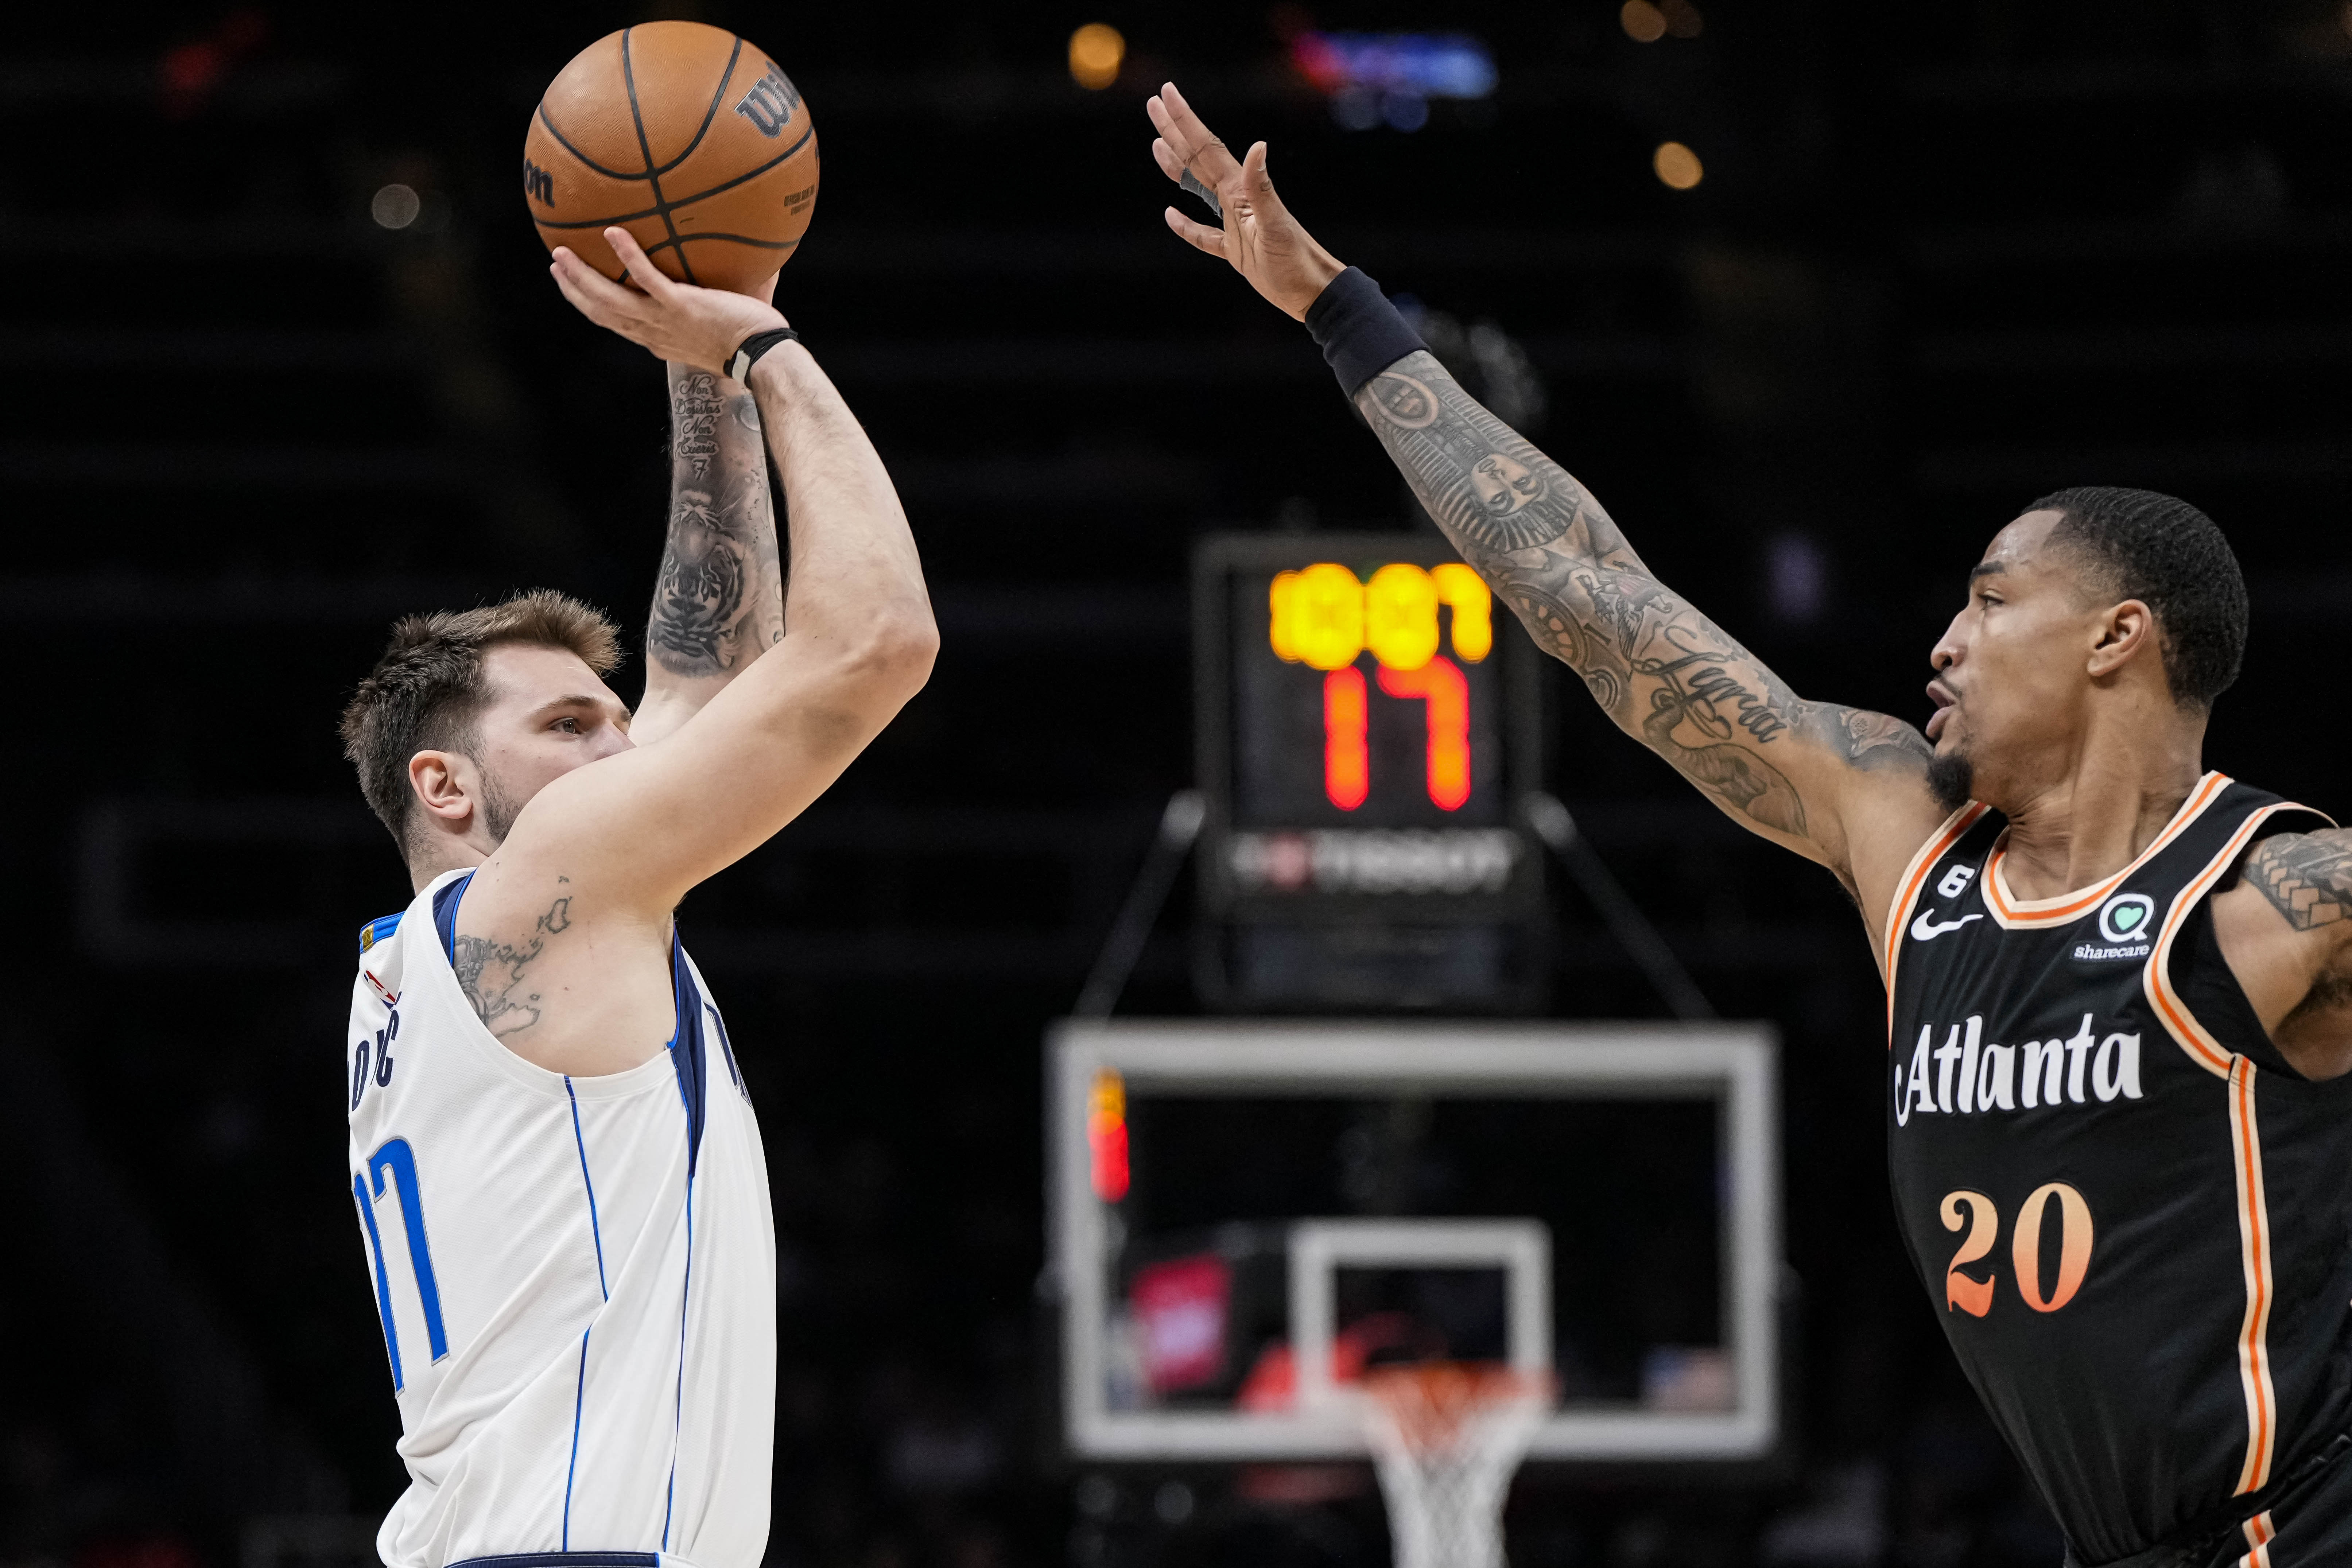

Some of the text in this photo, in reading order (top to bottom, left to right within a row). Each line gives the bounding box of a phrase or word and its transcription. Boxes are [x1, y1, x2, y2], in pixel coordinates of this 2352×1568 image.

[679, 376, 712, 395] Non
[683, 415, 714, 434] Non
[1937, 864, 1975, 898] 6
[2074, 943, 2150, 959] sharecare
[1895, 1012, 2144, 1127] Atlanta
[1940, 1182, 2093, 1317] 20
